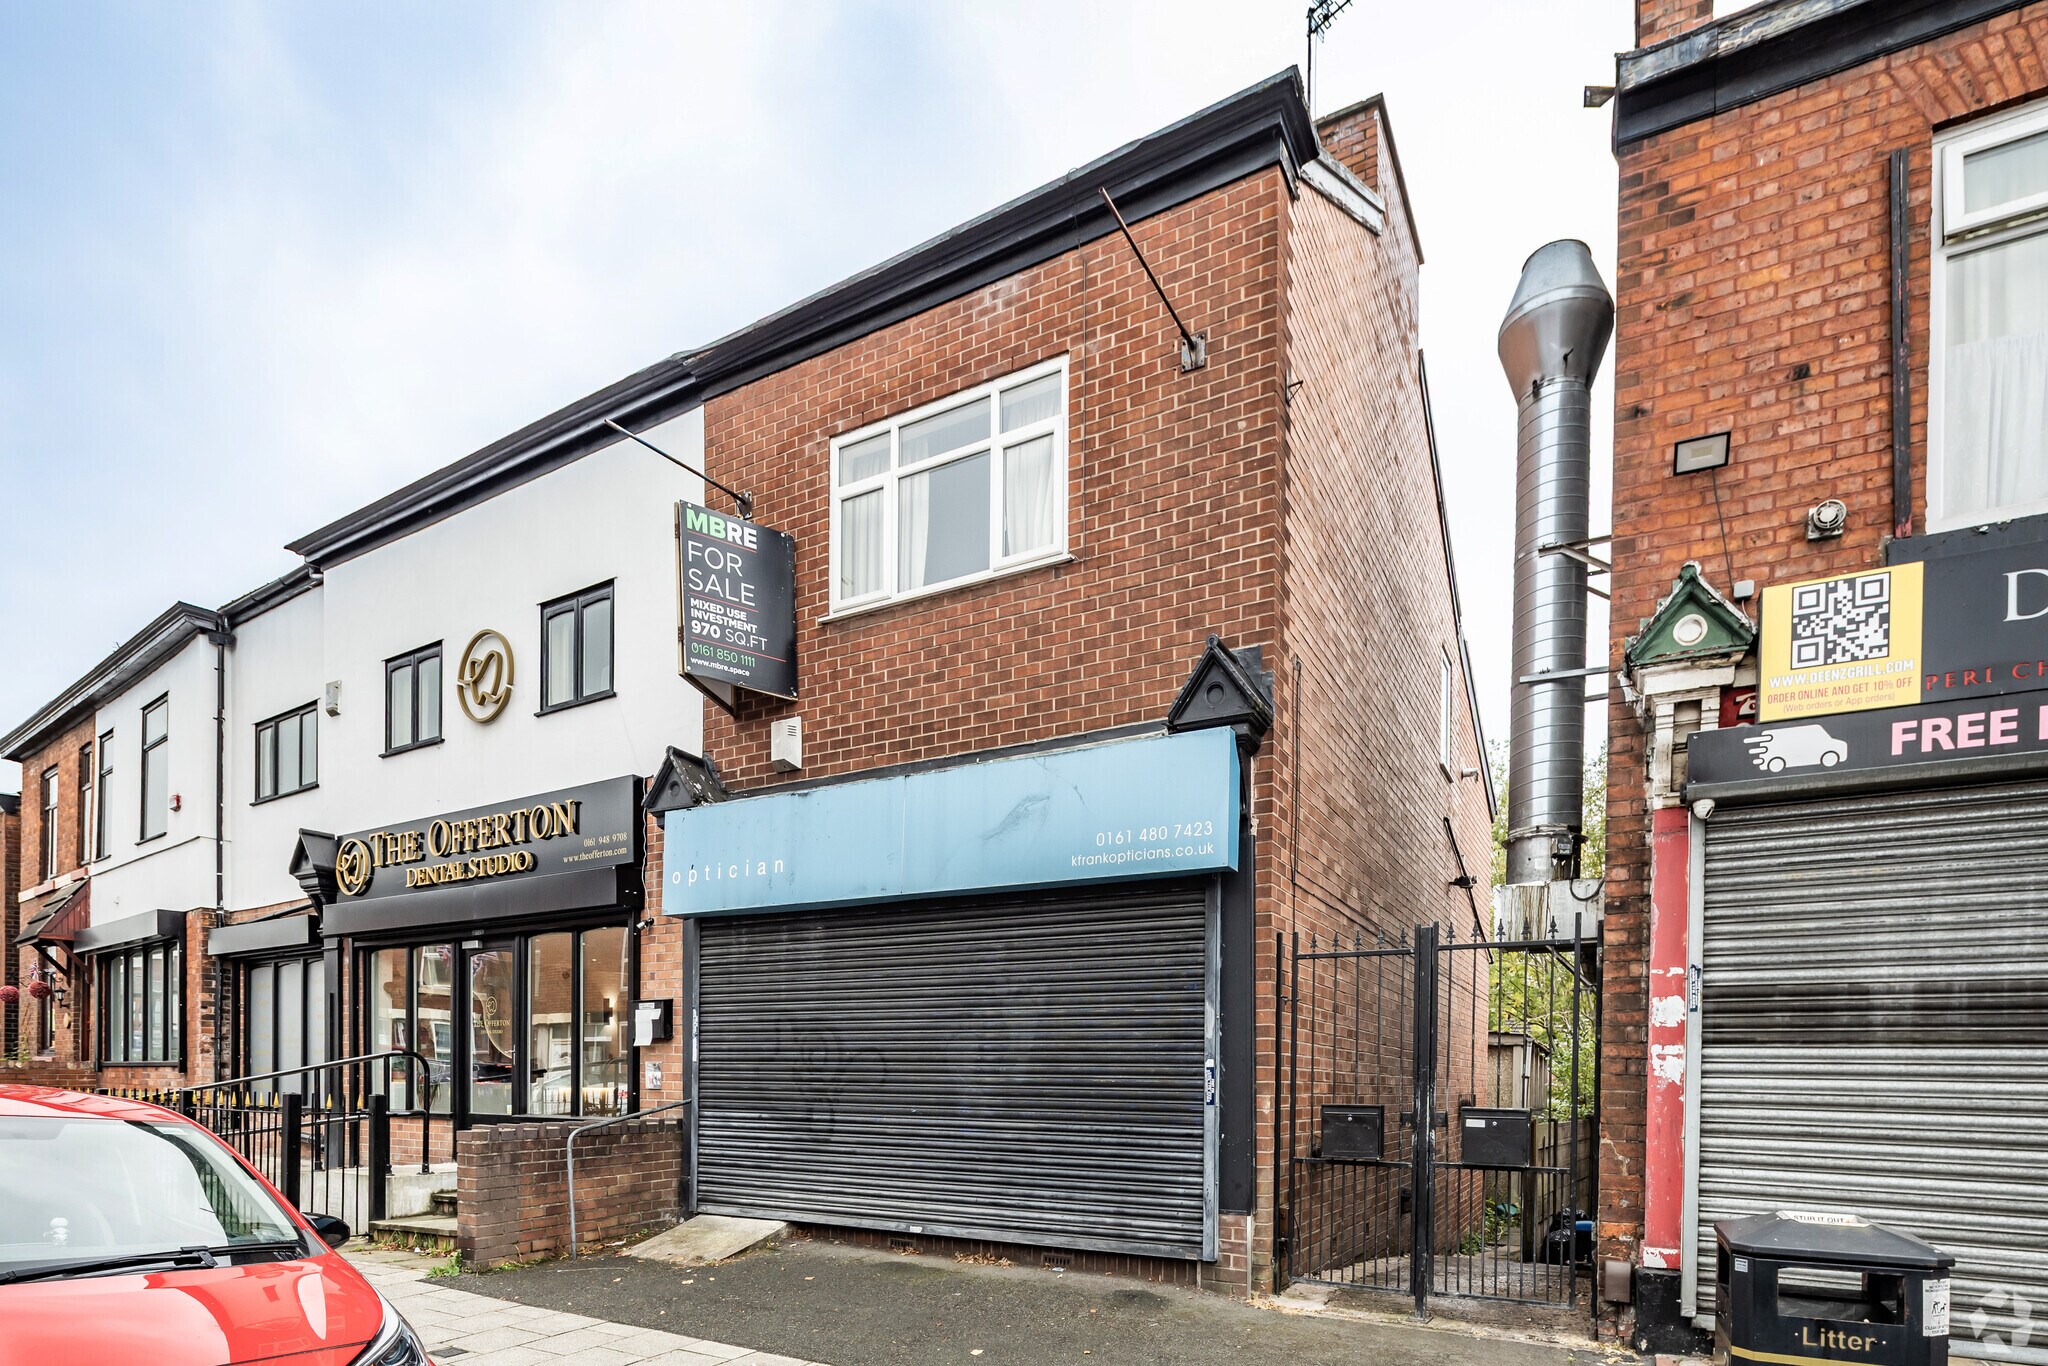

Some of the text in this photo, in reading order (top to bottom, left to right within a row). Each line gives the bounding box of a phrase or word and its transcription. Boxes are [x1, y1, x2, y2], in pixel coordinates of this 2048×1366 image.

[686, 507, 758, 550] MBRE
[688, 540, 743, 577] FOR
[688, 568, 756, 607] SALE
[690, 597, 747, 621] MIXED USE
[690, 607, 758, 634] INVESTMENT
[691, 619, 768, 651] 970 SQ.FT
[690, 657, 750, 677] www.mbre.space
[691, 642, 756, 668] 0161 850 1111
[1769, 658, 1914, 689] WWW.DEENZGRILL.COM
[1925, 667, 1992, 691] PERI
[1767, 677, 1913, 705] ORDER ONLINE AND GET 10% OFF
[1783, 691, 1895, 714] (Web orders or App orders)
[1891, 708, 2019, 756] FREE
[368, 799, 575, 868] THE OFFERTON
[583, 832, 628, 848] 0161 948 9708
[1096, 820, 1213, 847] 0161 480 7423
[562, 847, 628, 864] www.theofferton.com
[1071, 842, 1214, 867] kfrankopticians.co.uk
[405, 850, 532, 889] DENTAL STUDIO
[672, 859, 784, 887] optician
[1802, 1326, 1876, 1352] Litter
